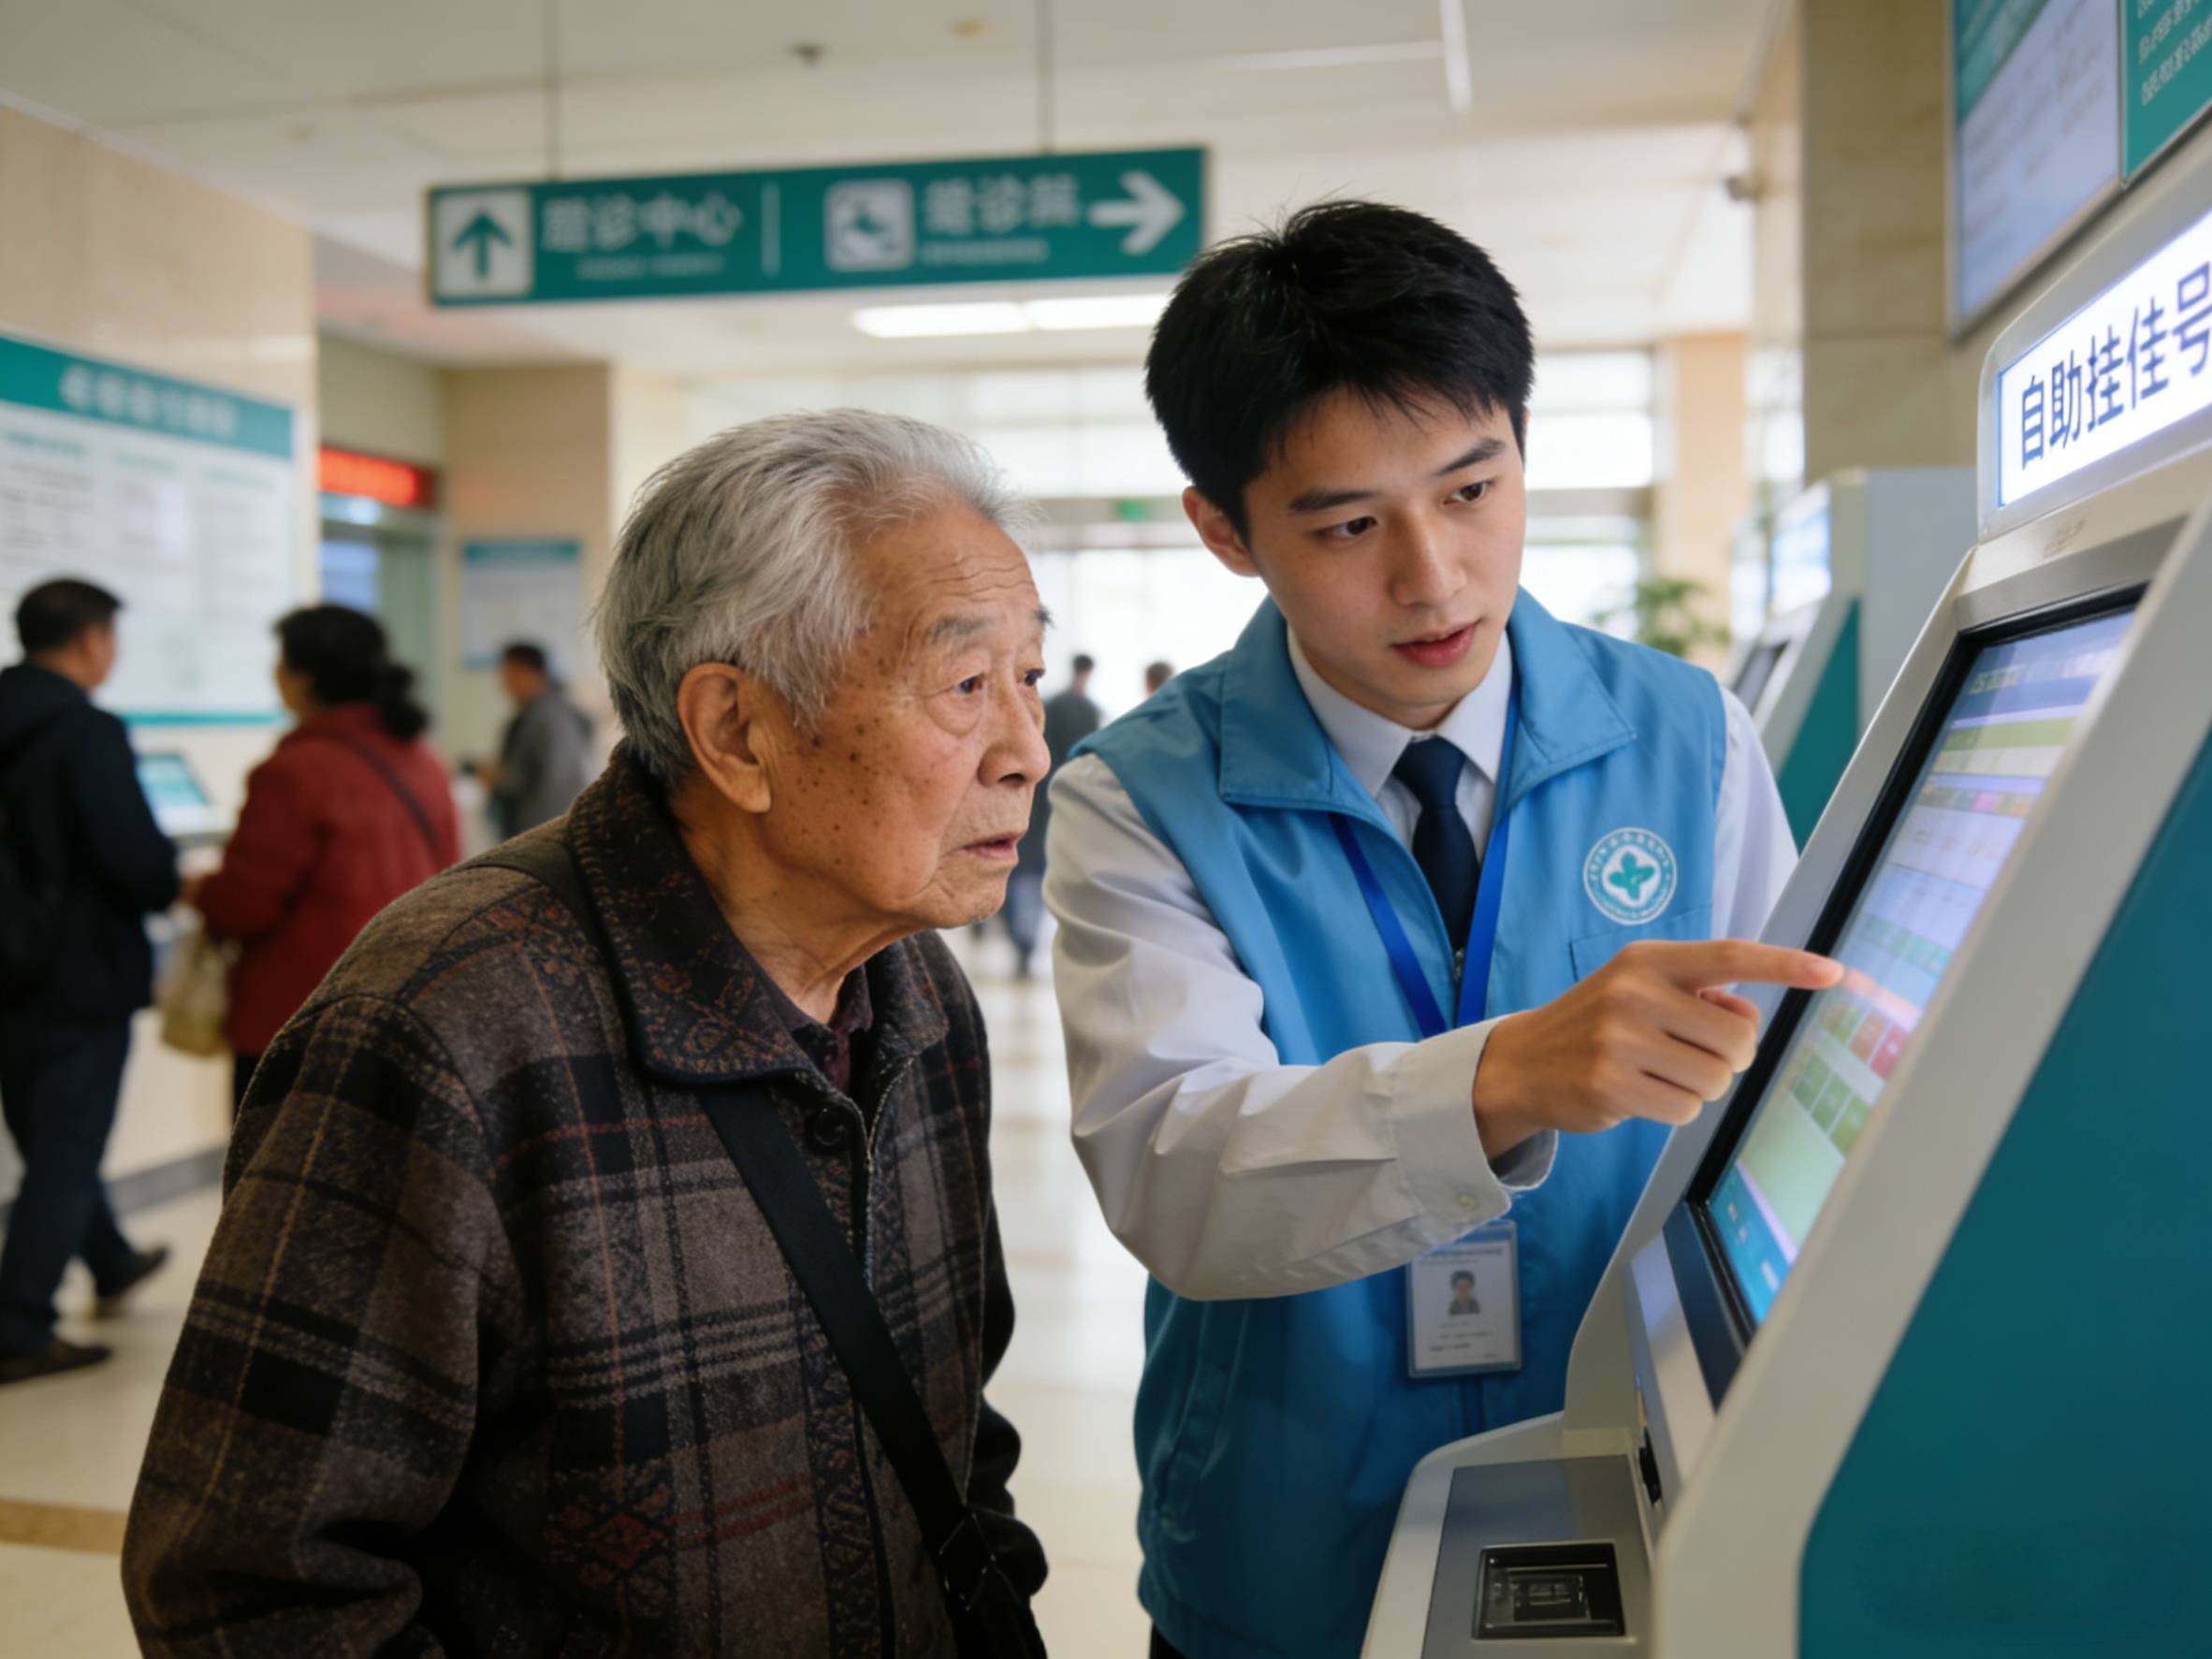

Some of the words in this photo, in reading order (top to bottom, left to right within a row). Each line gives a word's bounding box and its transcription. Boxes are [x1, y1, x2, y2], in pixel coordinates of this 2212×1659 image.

[2021, 260, 2212, 470] 自助挂佳号
